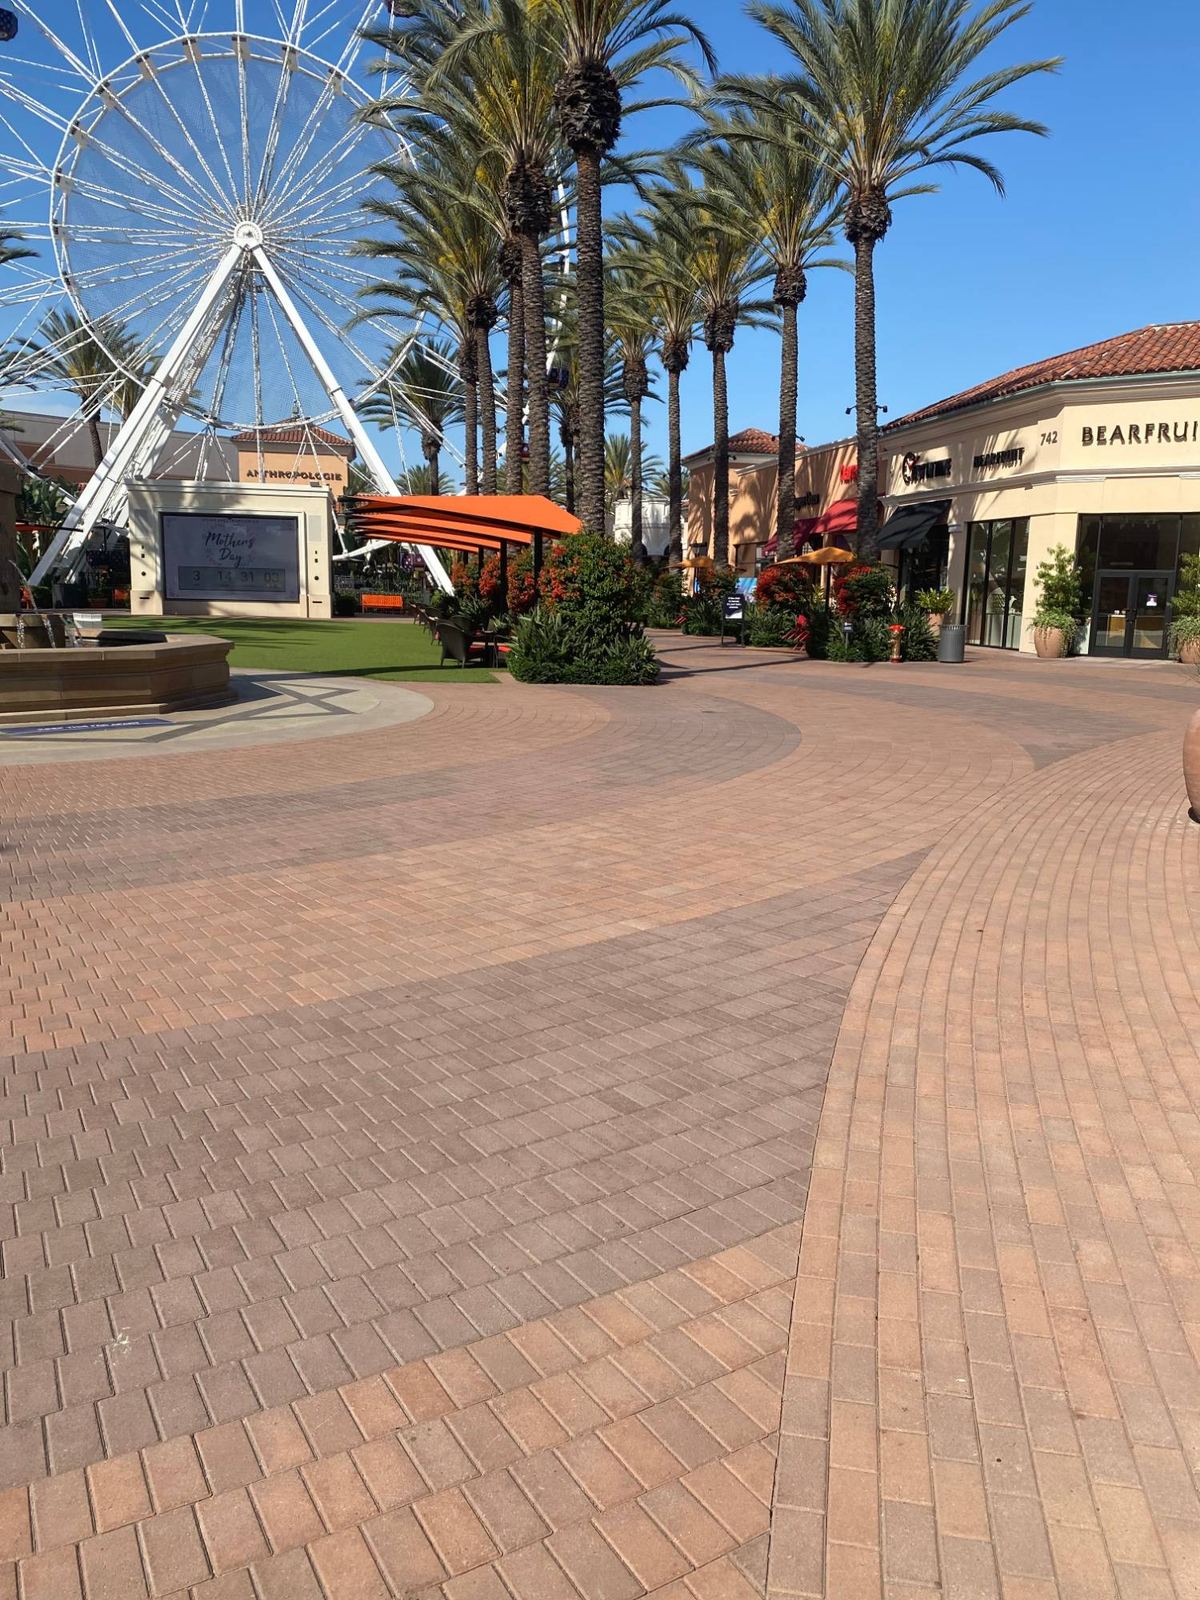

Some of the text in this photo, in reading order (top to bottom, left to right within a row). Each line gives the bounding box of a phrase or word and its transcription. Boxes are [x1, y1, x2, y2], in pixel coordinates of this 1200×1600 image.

[1040, 431, 1058, 446] 742
[1082, 421, 1198, 446] BEARFRUI
[246, 469, 342, 481] ANTHROPOLOGIE
[219, 547, 243, 569] Day
[192, 570, 201, 582] 3
